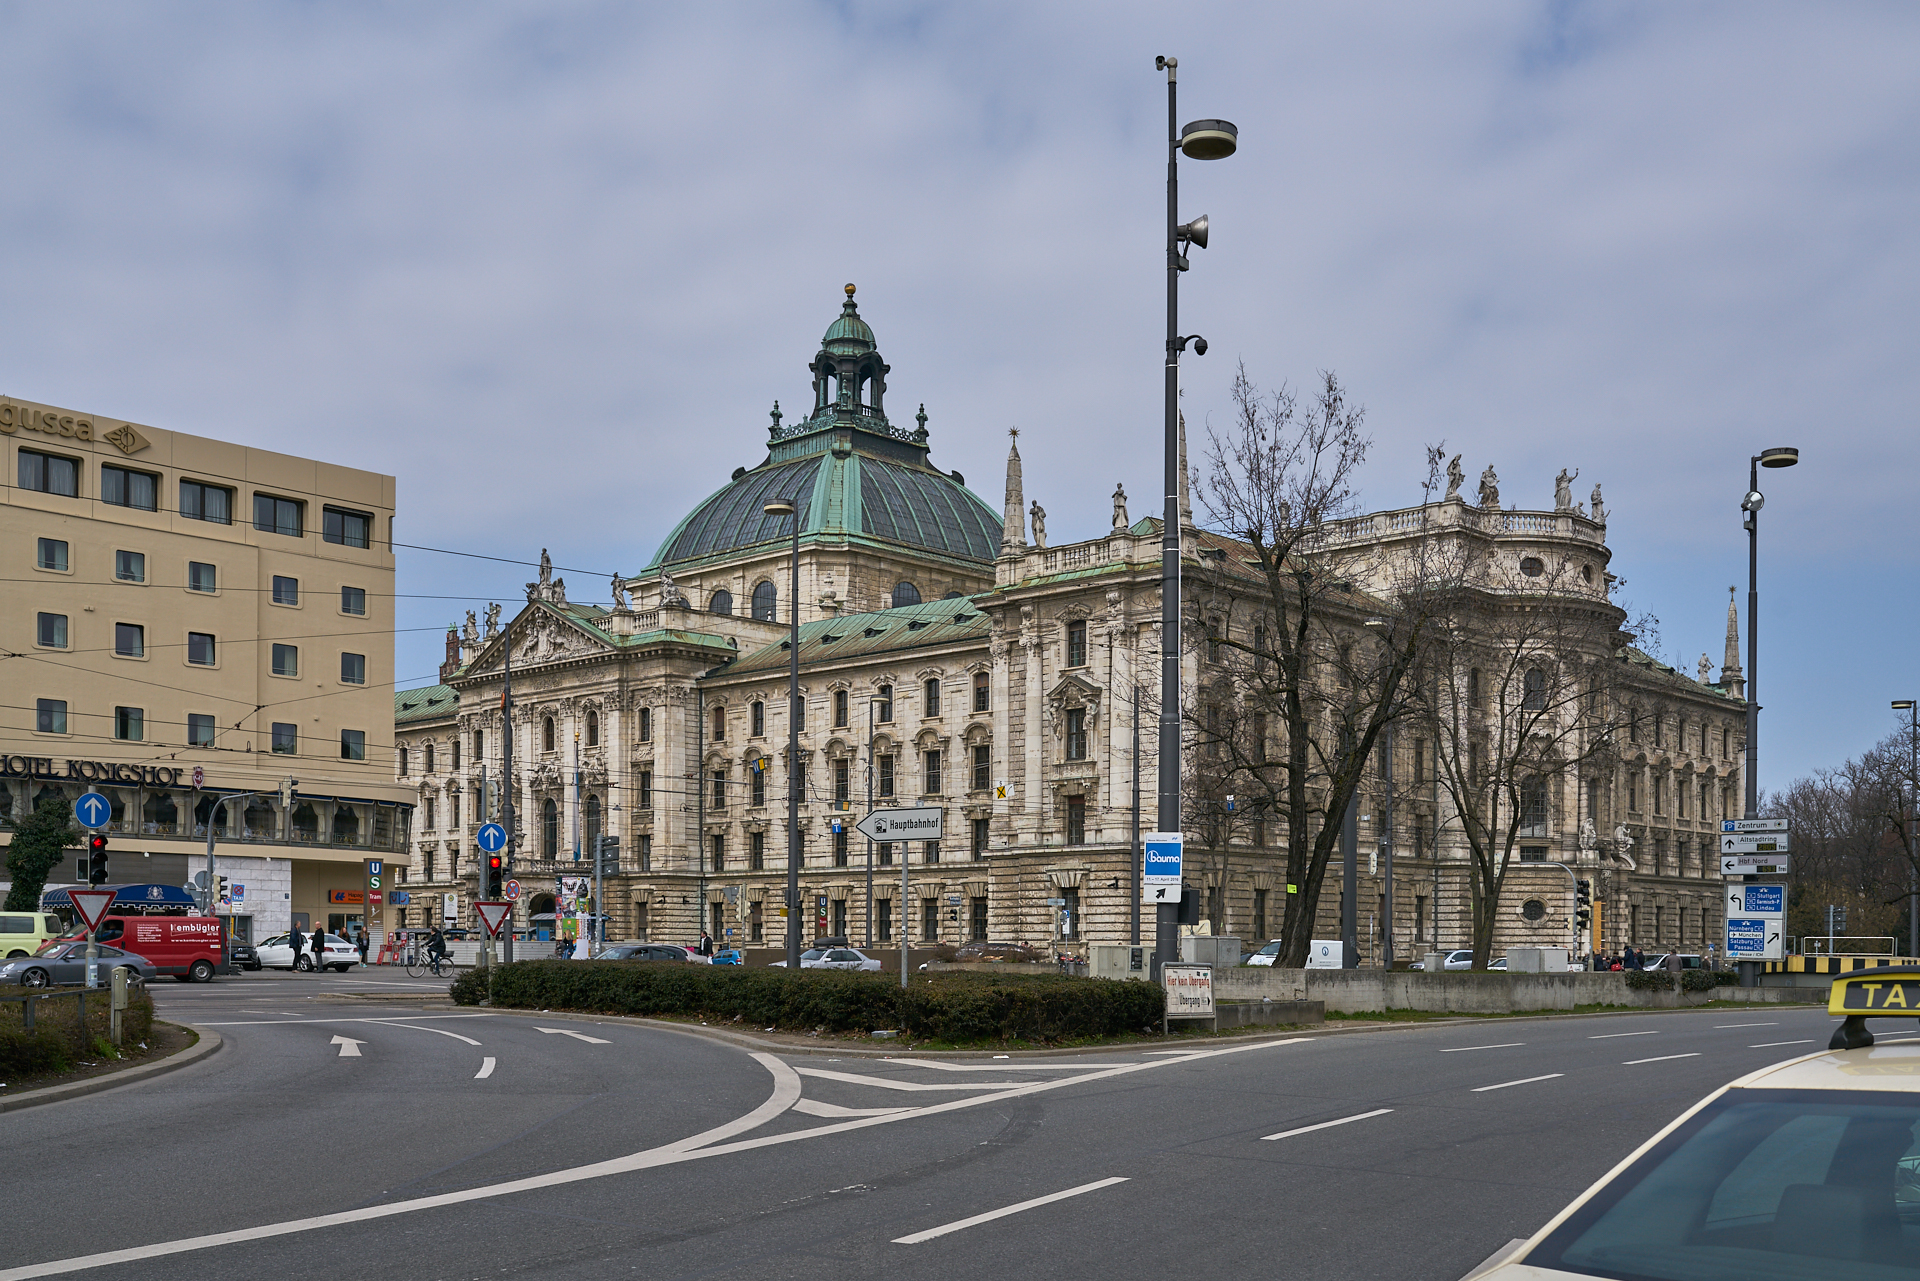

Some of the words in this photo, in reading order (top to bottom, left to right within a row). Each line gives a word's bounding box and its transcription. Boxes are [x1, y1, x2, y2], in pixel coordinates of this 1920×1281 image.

[889, 817, 939, 831] Hauptbahnhof
[1147, 850, 1180, 862] bauma
[371, 863, 379, 873] U
[370, 876, 380, 888] S
[820, 897, 826, 906] U
[820, 908, 826, 917] S
[1189, 973, 1209, 988] Übergang
[1179, 992, 1200, 1007] Übergang
[1861, 983, 1920, 1008] TA
